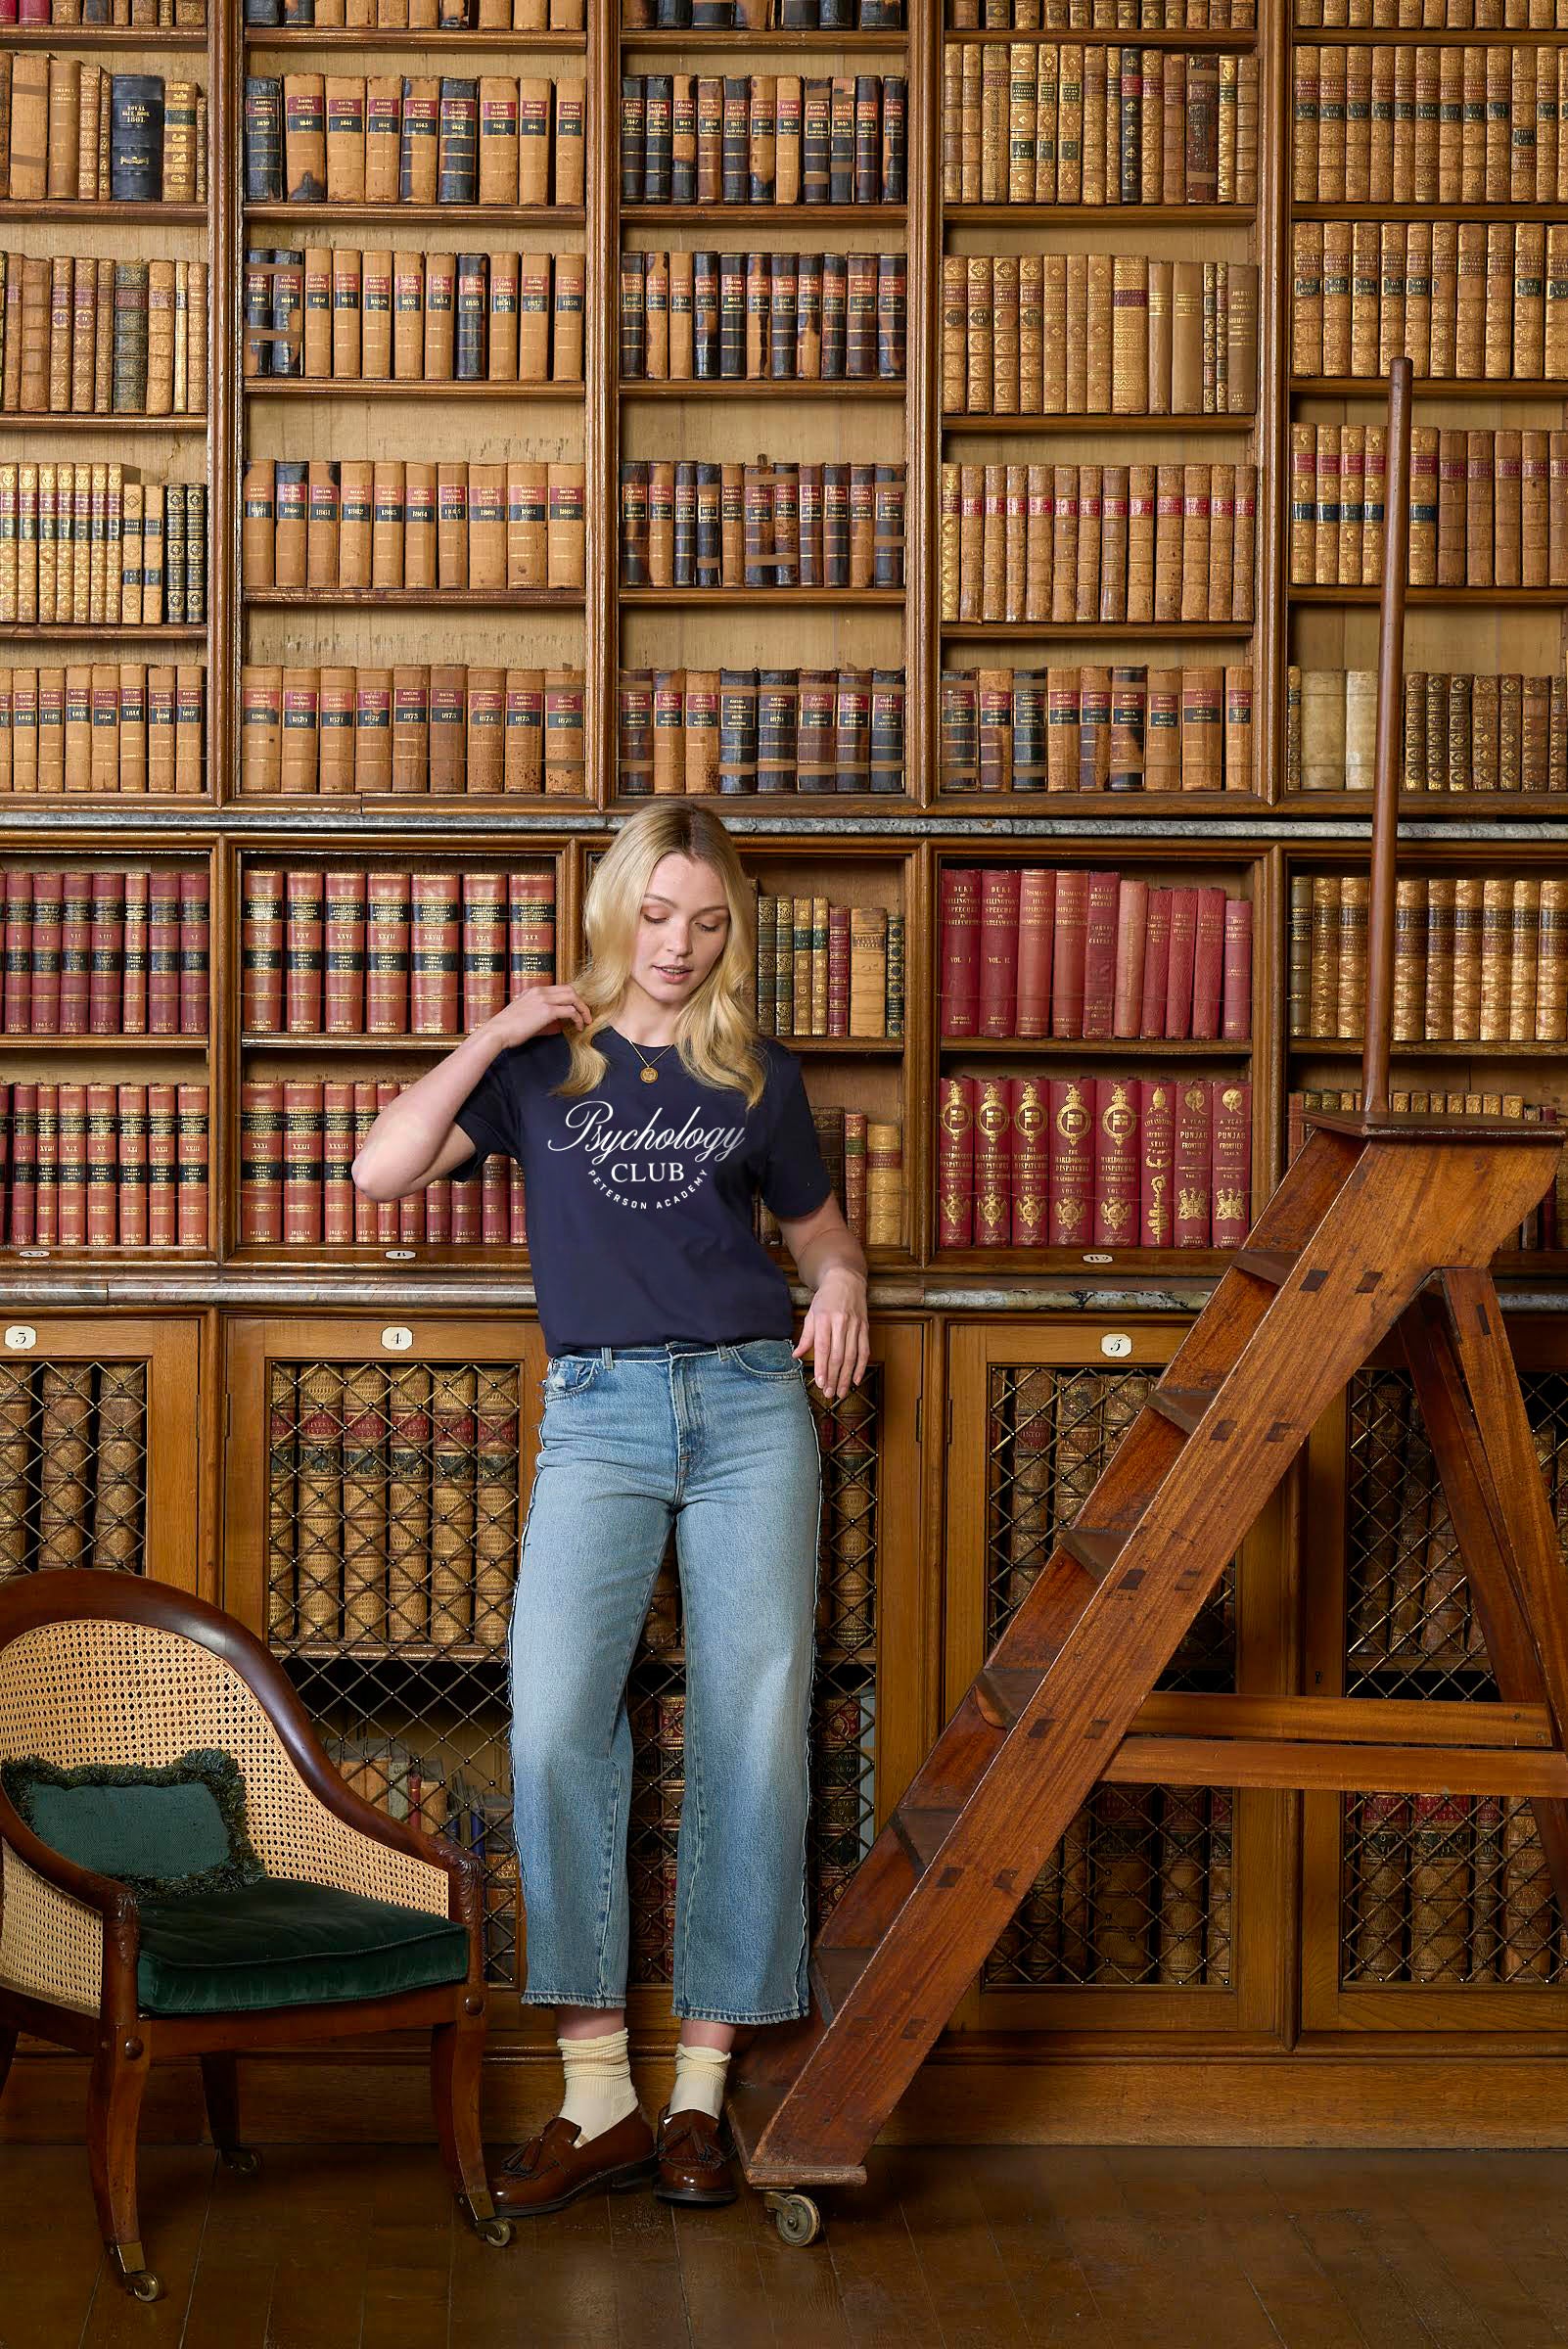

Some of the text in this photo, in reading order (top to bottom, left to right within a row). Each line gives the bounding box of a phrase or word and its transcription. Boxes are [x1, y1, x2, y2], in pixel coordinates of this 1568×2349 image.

[547, 1100, 745, 1166] Psychology
[611, 1163, 685, 1183] CLUB
[588, 1169, 708, 1210] PETERSON ACADEMY
[16, 1332, 26, 1345] 3
[391, 1332, 402, 1345] 4
[1110, 1338, 1123, 1352] 5
